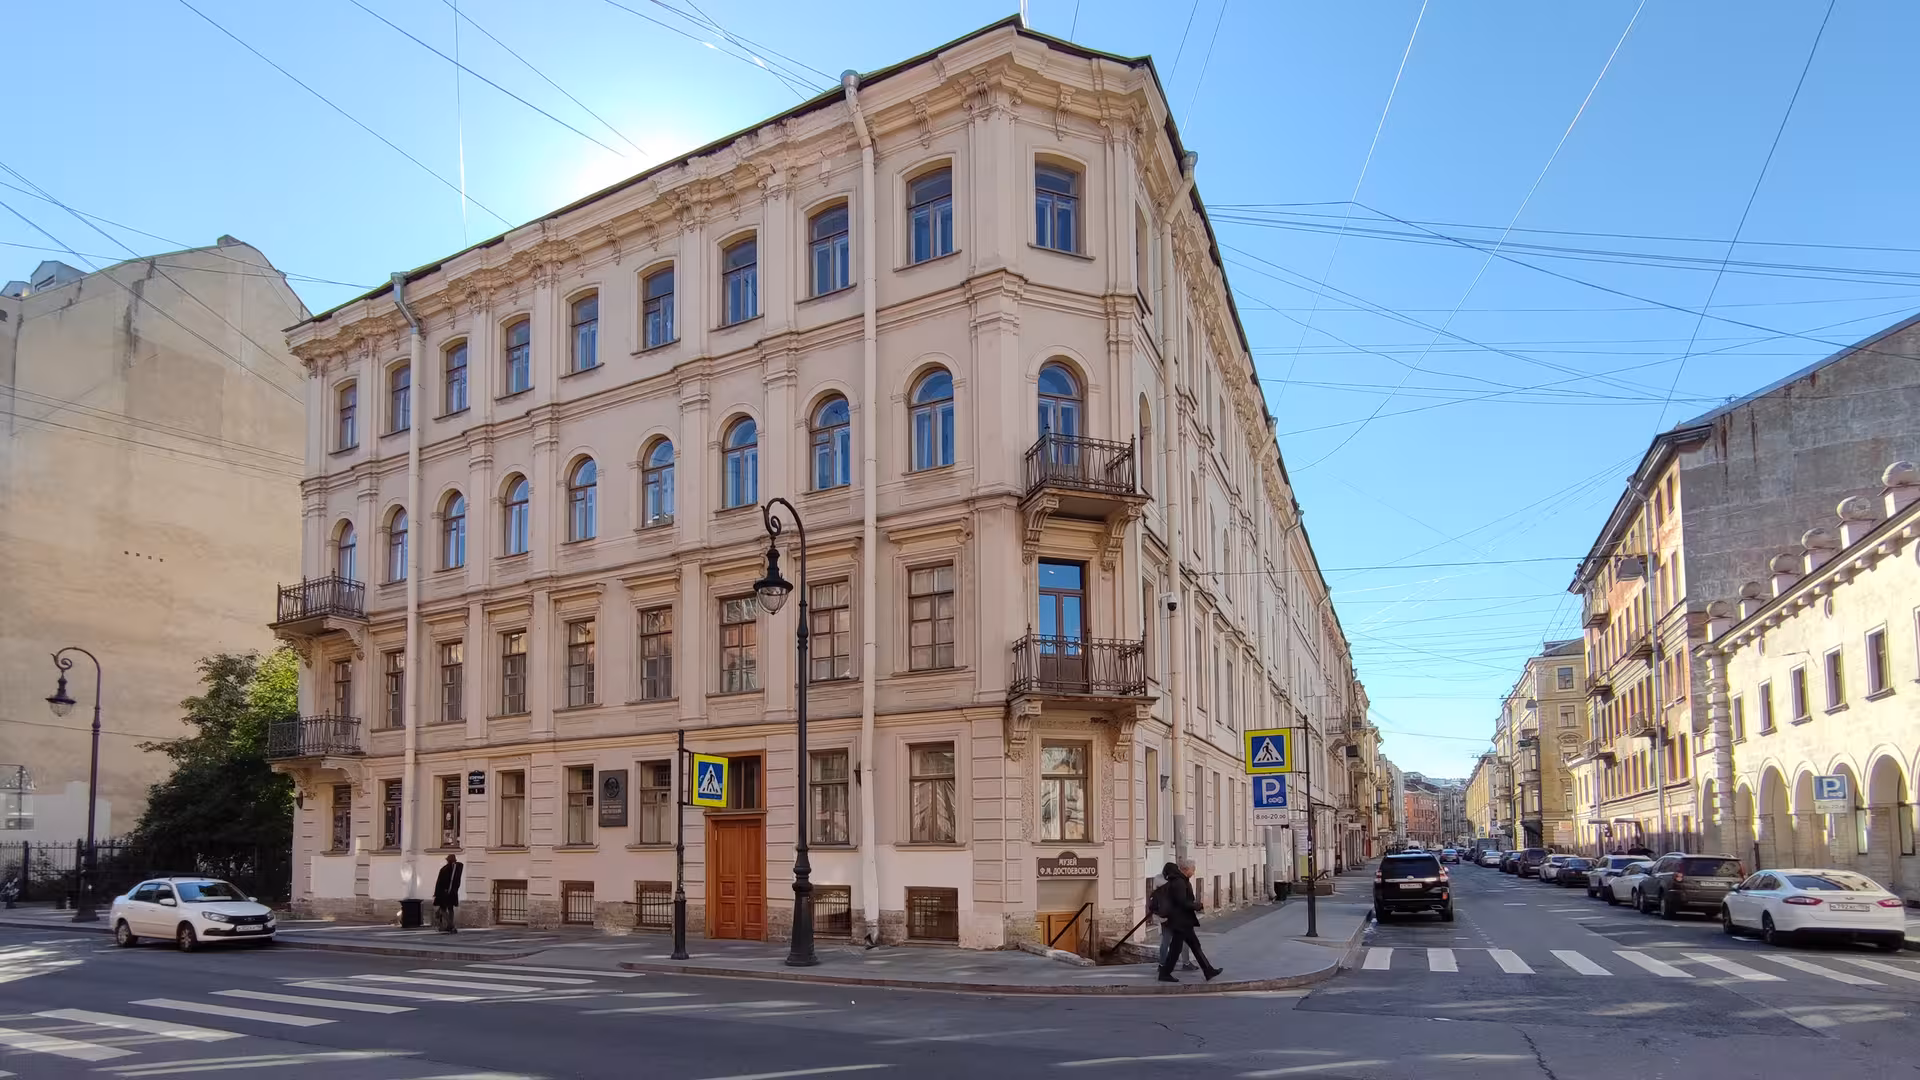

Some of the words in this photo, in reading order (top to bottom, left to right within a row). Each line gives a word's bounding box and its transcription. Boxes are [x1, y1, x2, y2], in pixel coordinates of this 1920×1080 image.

[1262, 779, 1280, 804] P
[1822, 778, 1840, 797] P
[1058, 857, 1077, 866] МУЗЕЙ
[1053, 867, 1096, 876] ДОСТОЕВСКОГО
